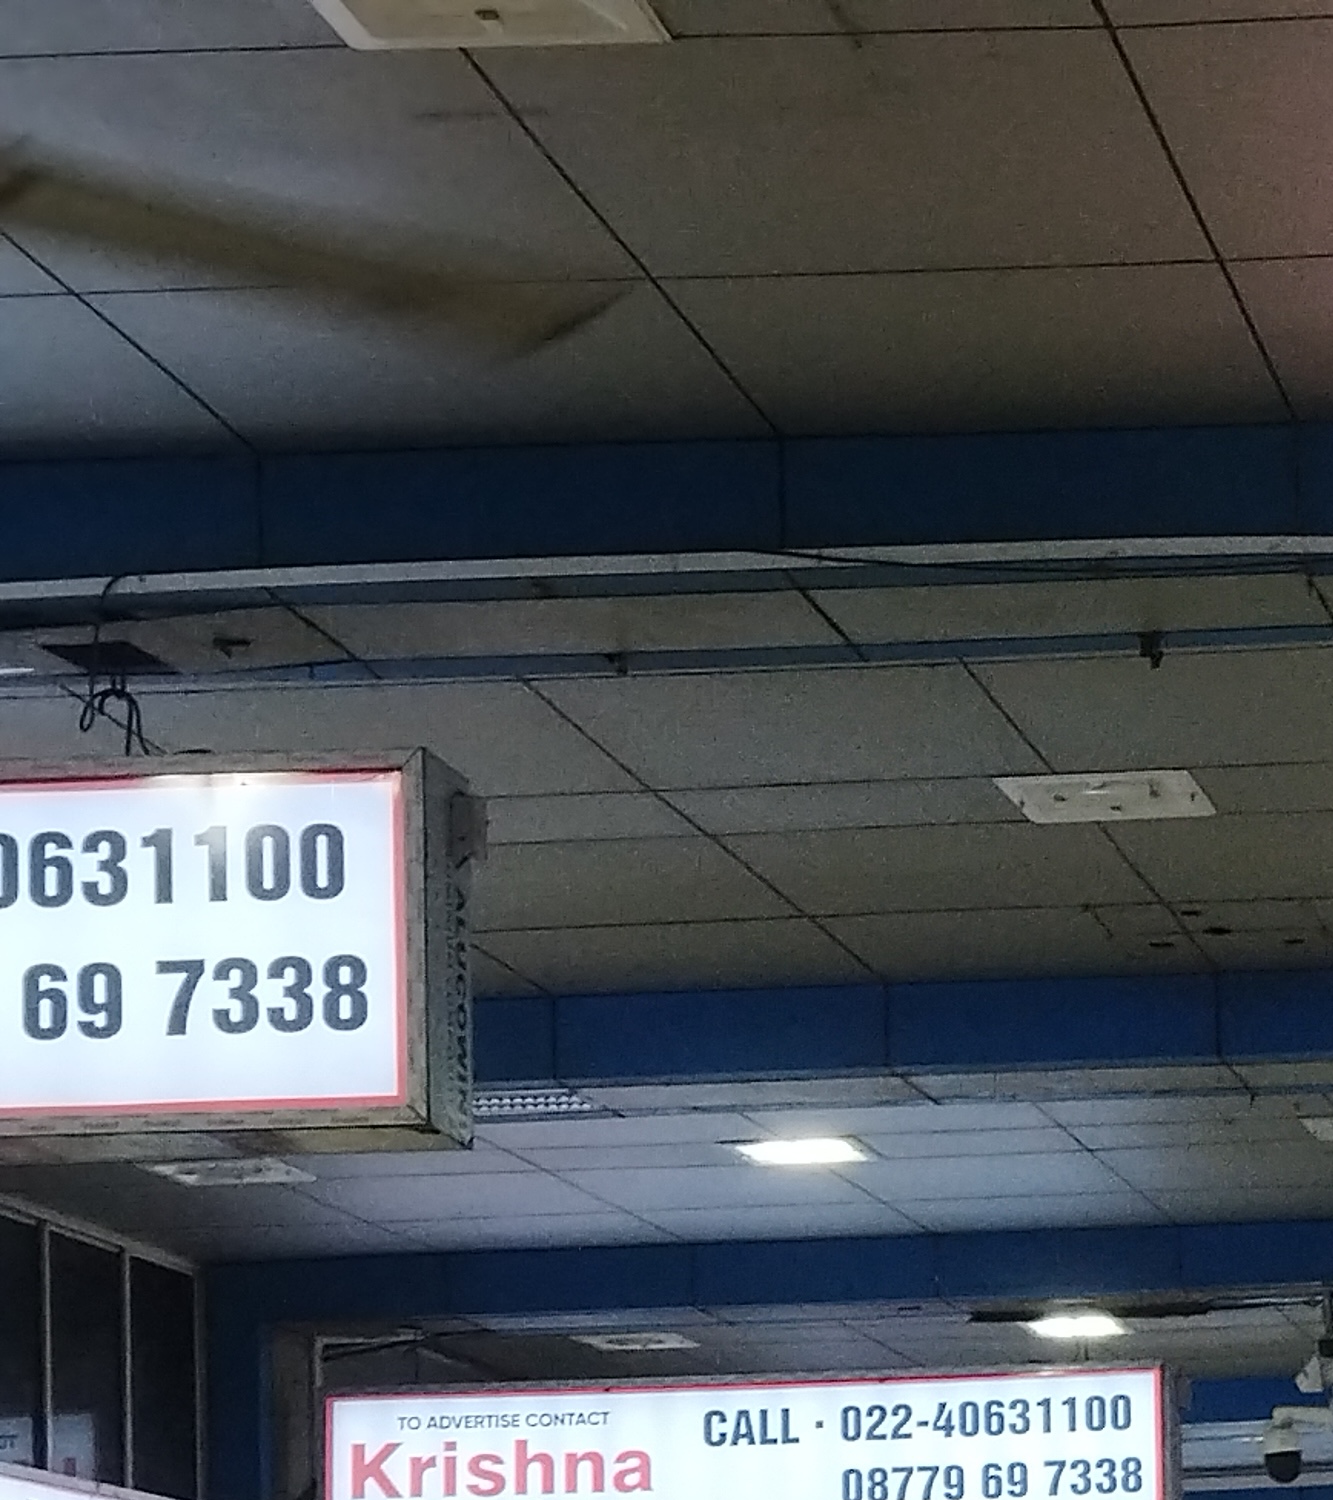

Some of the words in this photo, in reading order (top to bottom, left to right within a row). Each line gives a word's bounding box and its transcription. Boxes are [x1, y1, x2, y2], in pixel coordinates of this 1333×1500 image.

[21, 962, 123, 1040] 69
[155, 953, 368, 1036] 7338
[398, 1416, 421, 1430] TO
[427, 1413, 520, 1429] ADVERTISE
[526, 1411, 611, 1426] CONTACT
[703, 1408, 799, 1446] CALL
[840, 1394, 1133, 1441] 022-40631100
[351, 1439, 653, 1499] Krishna
[982, 1461, 1028, 1498] 69
[1043, 1457, 1142, 1496] 7338
